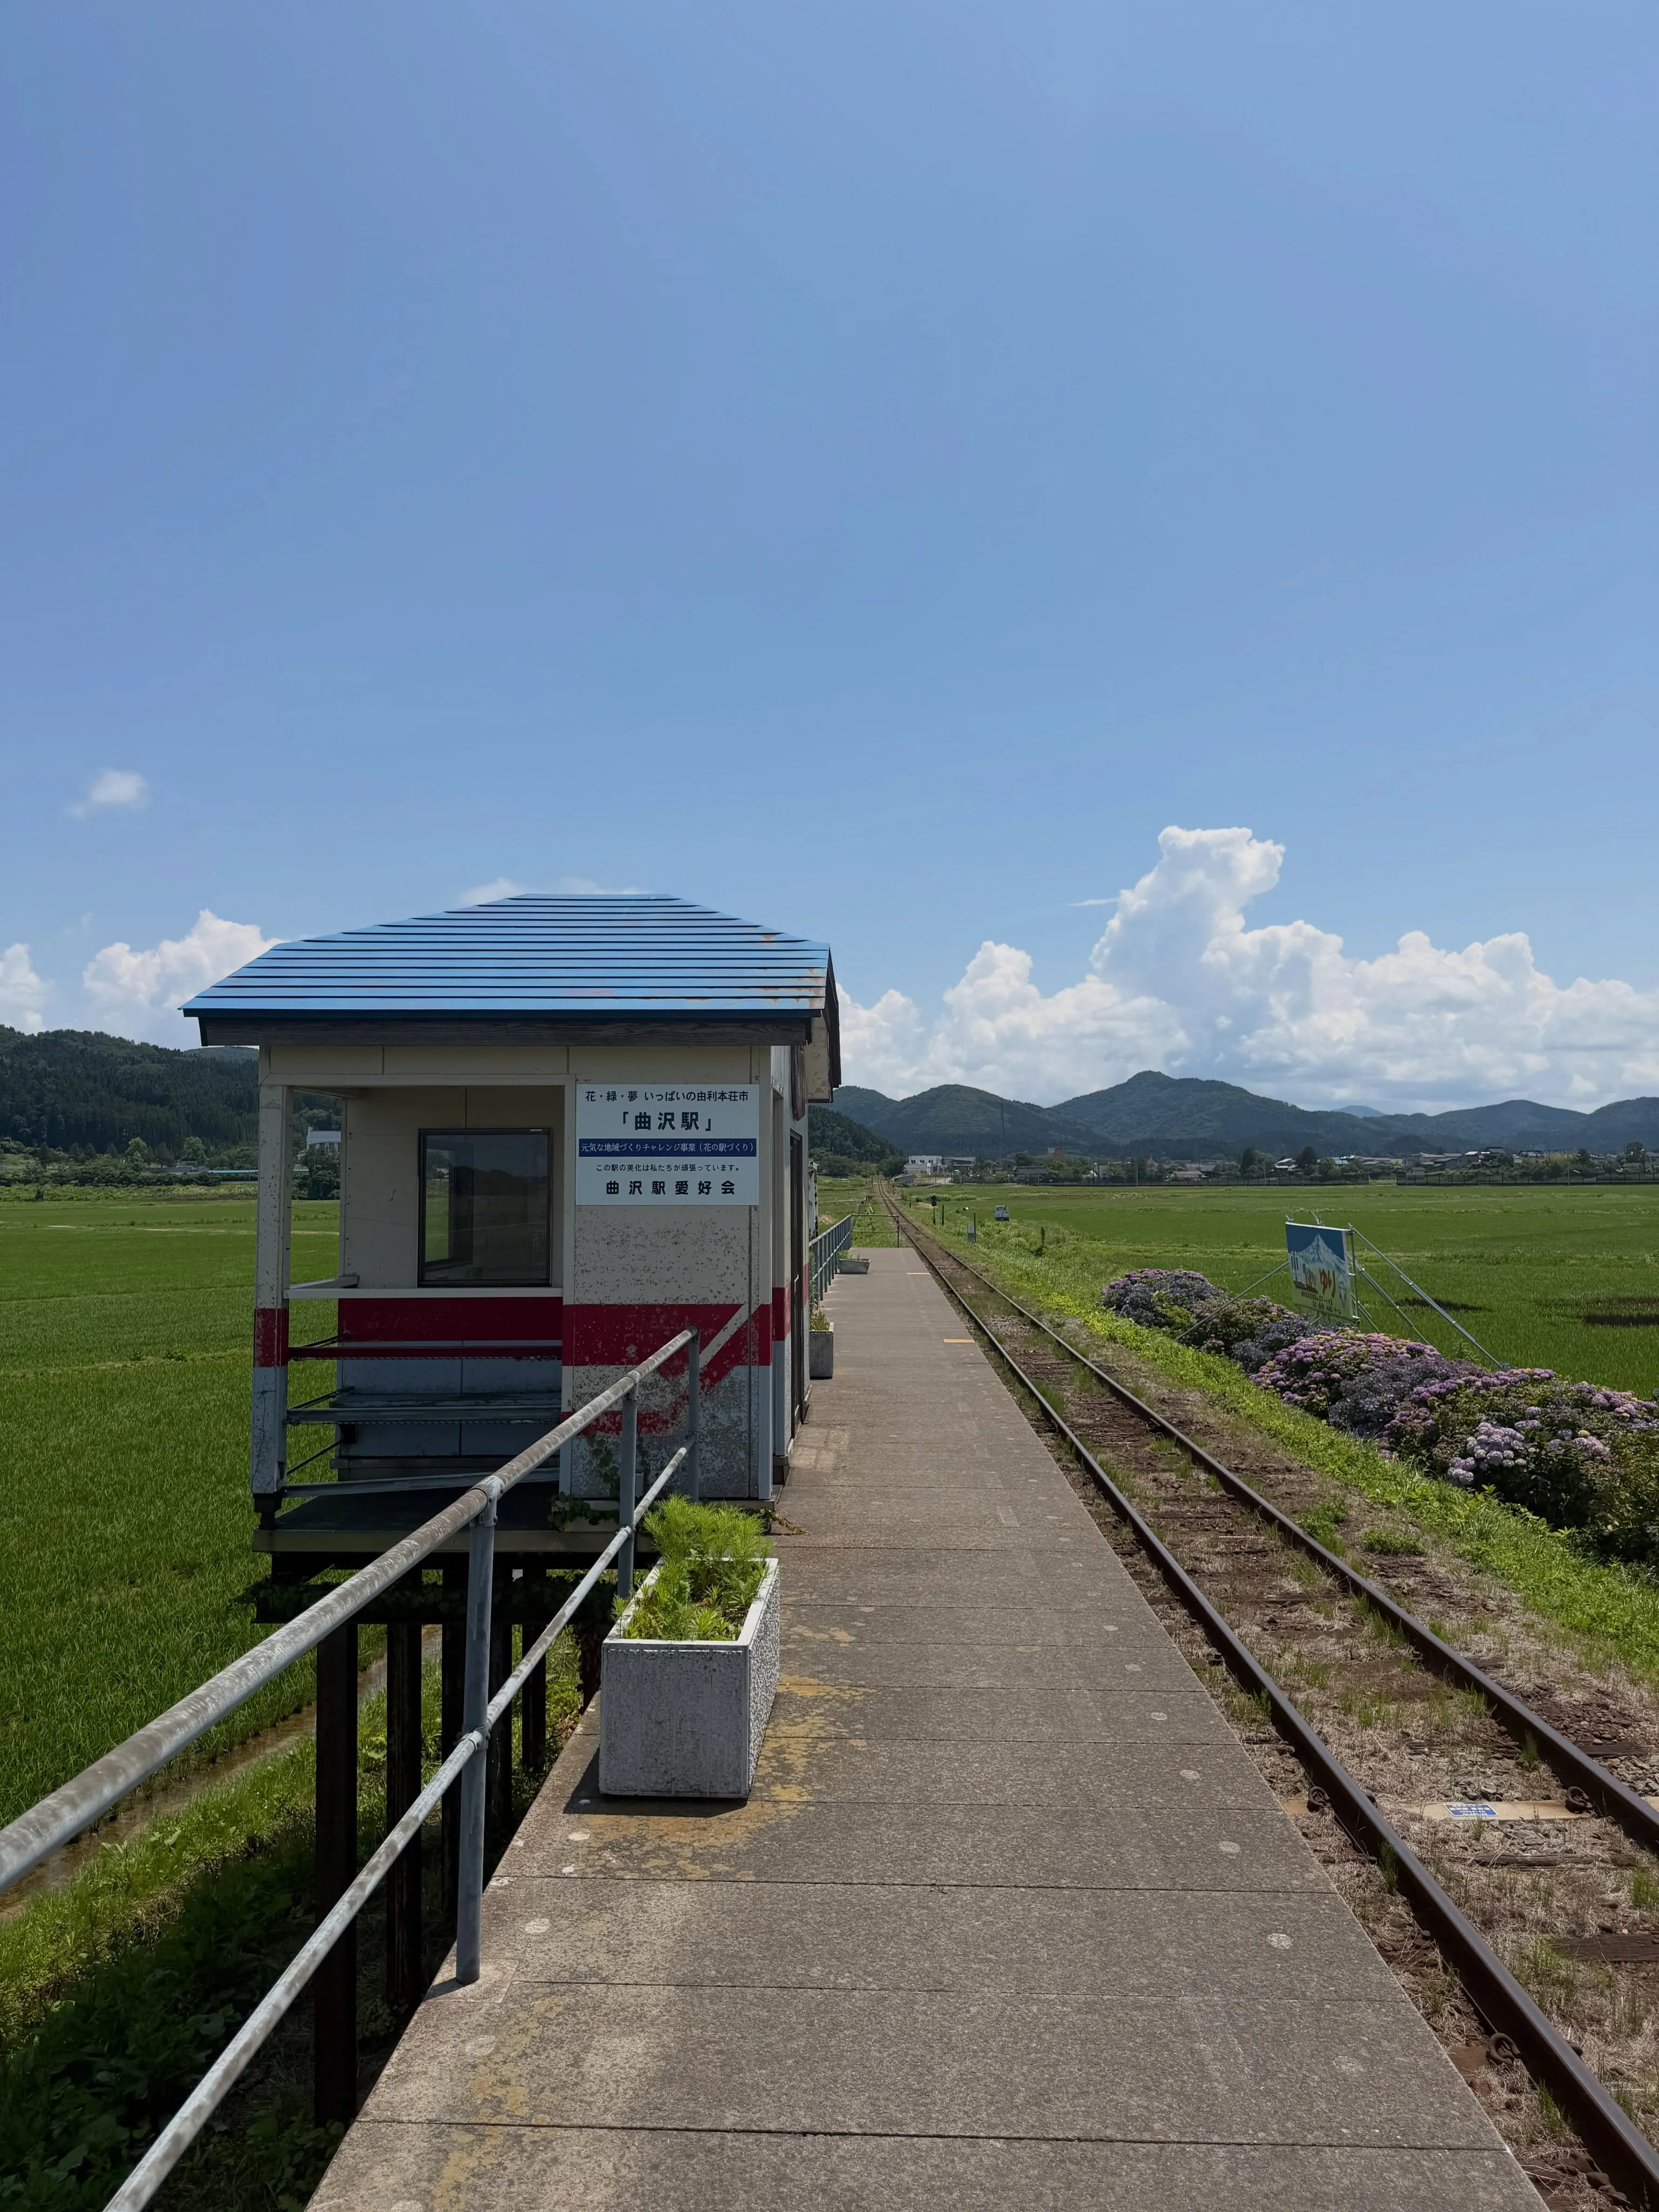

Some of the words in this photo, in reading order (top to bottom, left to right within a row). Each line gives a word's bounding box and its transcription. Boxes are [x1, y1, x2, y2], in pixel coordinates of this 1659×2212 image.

[585, 1091, 638, 1102] 花・緑・夢
[644, 1090, 748, 1102] いっぱいの由利本荘市
[622, 1111, 711, 1131] 「曲沢駅」
[596, 1164, 739, 1172] この駅の美化は私たちが頑張っています。
[606, 1180, 735, 1195] 曲沢駅愛好会
[1319, 1267, 1336, 1299] ゆり
